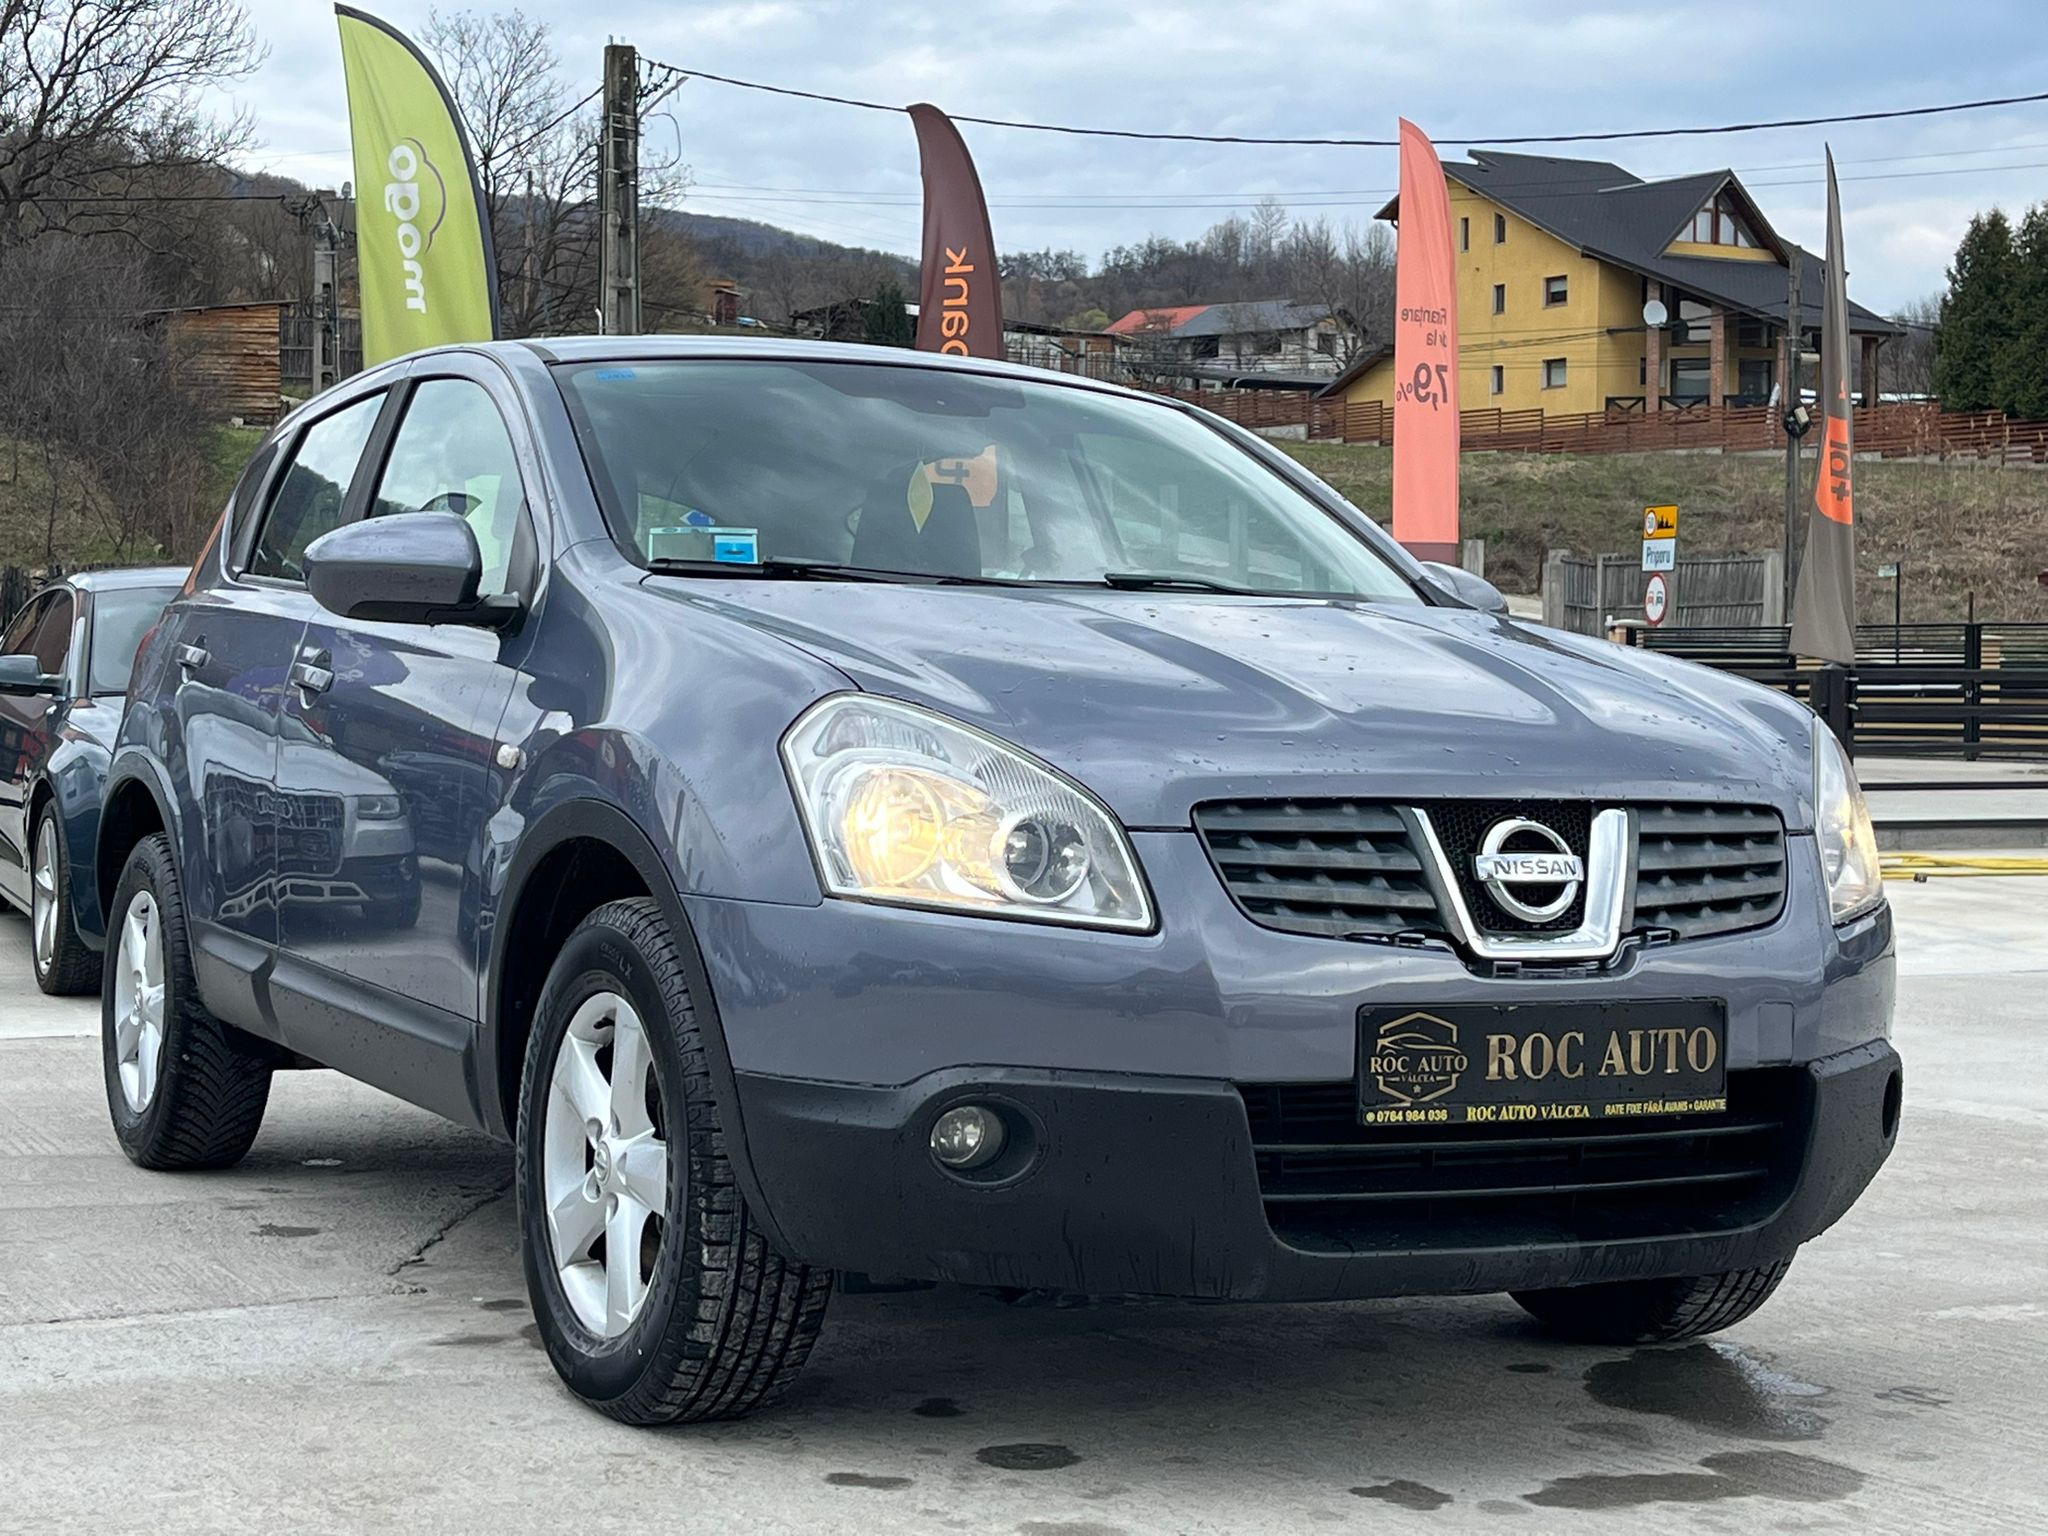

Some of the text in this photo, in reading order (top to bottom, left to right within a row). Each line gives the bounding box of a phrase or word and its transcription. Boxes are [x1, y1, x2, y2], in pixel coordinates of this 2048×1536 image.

[1493, 859, 1577, 876] NISSAN
[1485, 1027, 1718, 1081] ROC AUTO
[1370, 1054, 1468, 1073] ROC AUTO
[1466, 1106, 1497, 1121] ROC
[1499, 1104, 1537, 1120] AUTO
